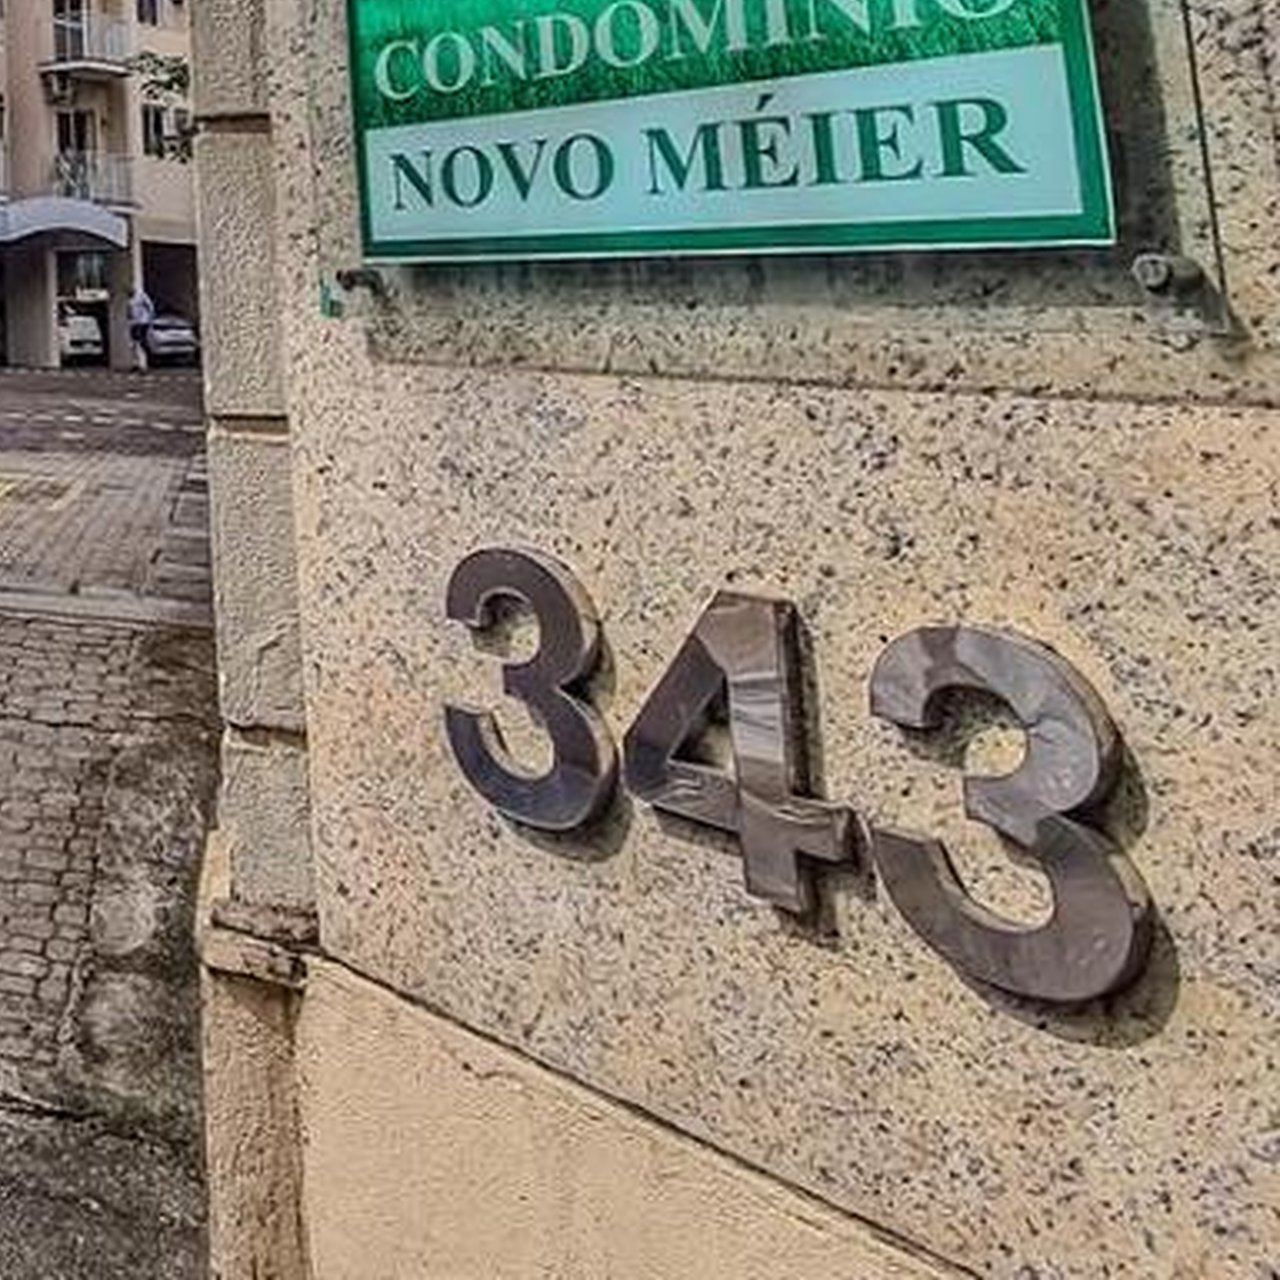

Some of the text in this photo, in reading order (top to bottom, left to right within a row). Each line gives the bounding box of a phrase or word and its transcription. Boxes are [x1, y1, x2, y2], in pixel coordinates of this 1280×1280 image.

[389, 93, 1027, 211] NOVO MÉIER
[445, 546, 1155, 1003] 343
